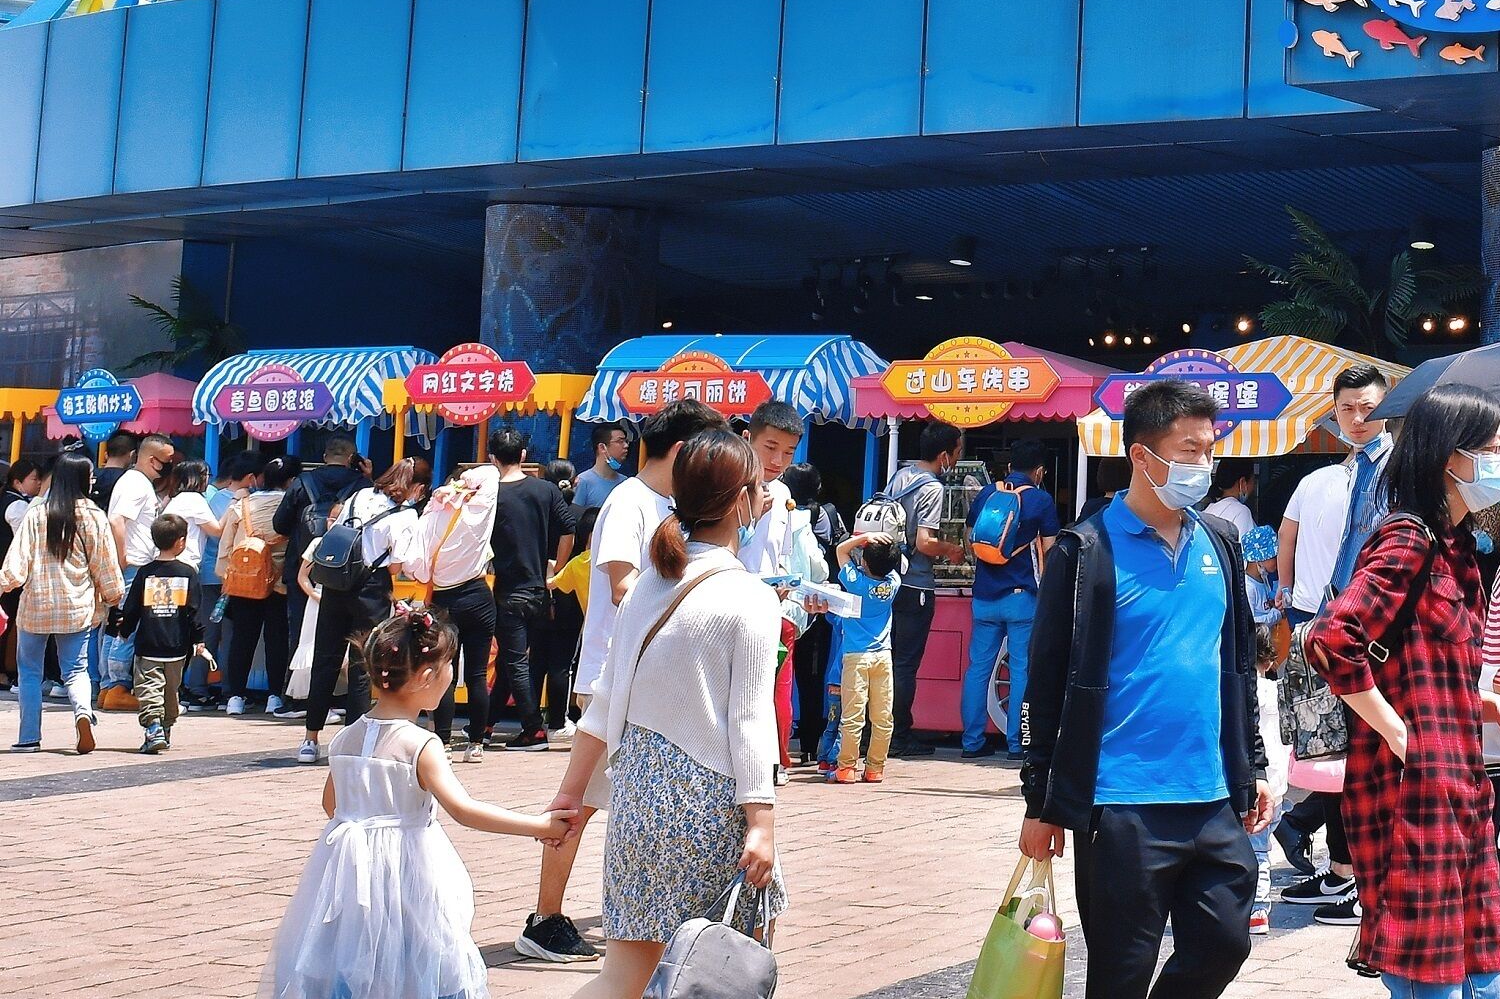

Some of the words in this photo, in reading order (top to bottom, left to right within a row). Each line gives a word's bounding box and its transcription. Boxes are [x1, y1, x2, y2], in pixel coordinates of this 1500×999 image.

[422, 368, 514, 394] 网红文字烧
[639, 379, 747, 404] 爆浆可丽饼
[906, 366, 1030, 394] 过山车烤串
[228, 388, 315, 413] 章鱼圆滚滚
[1021, 702, 1031, 746] BEYOND
